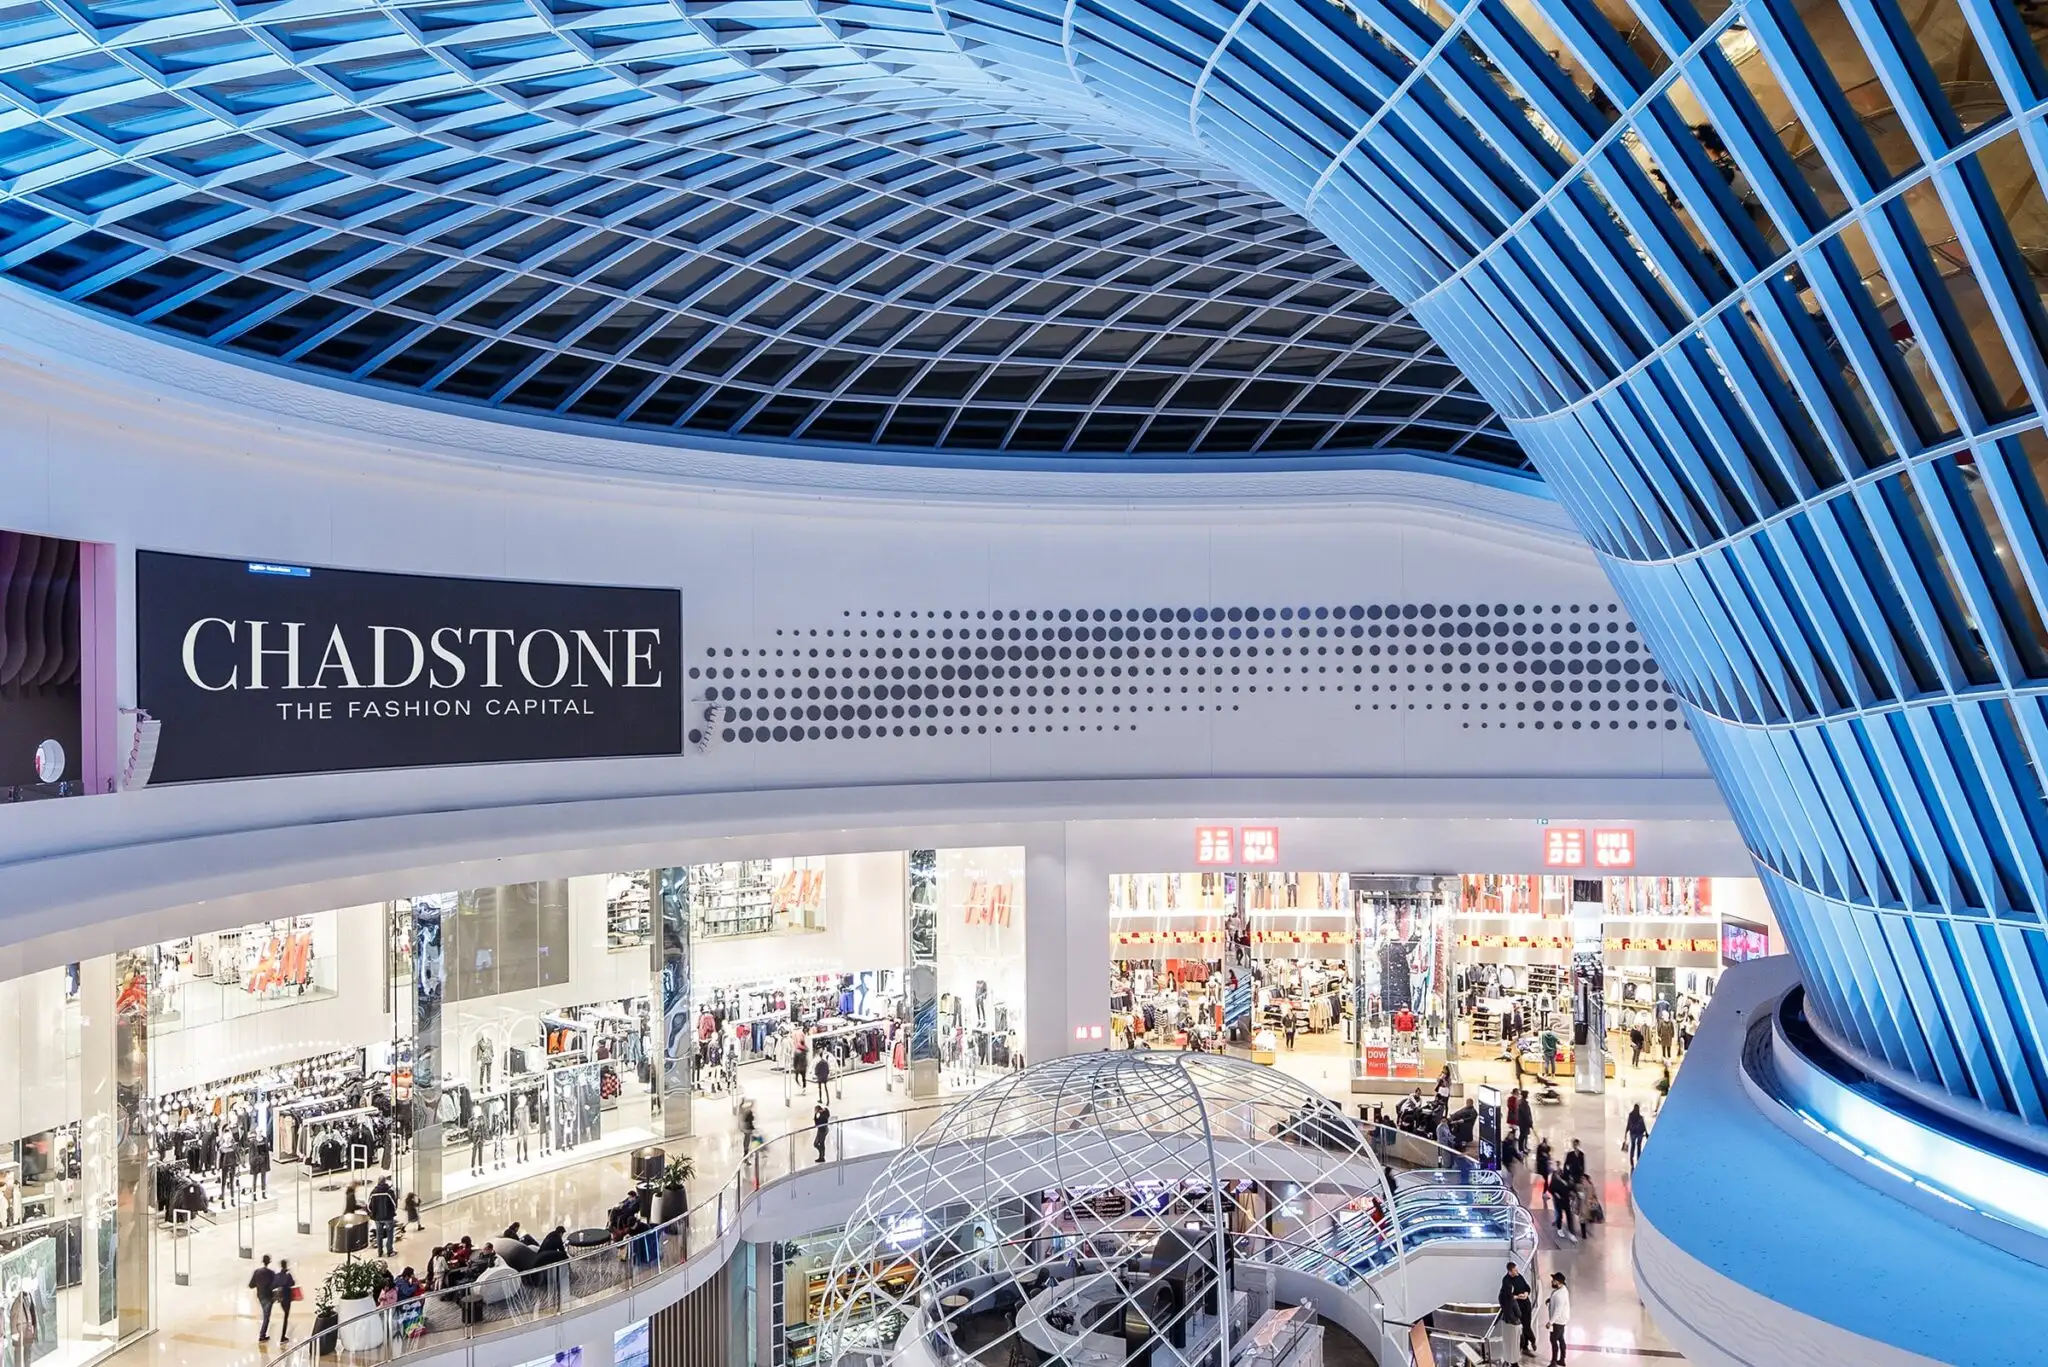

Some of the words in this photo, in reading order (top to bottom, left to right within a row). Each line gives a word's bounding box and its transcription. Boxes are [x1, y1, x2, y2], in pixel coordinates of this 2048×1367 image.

[181, 617, 663, 692] CHADSTONE
[276, 702, 333, 721] THE
[348, 699, 472, 719] FASHION
[485, 698, 595, 716] CAPITAL
